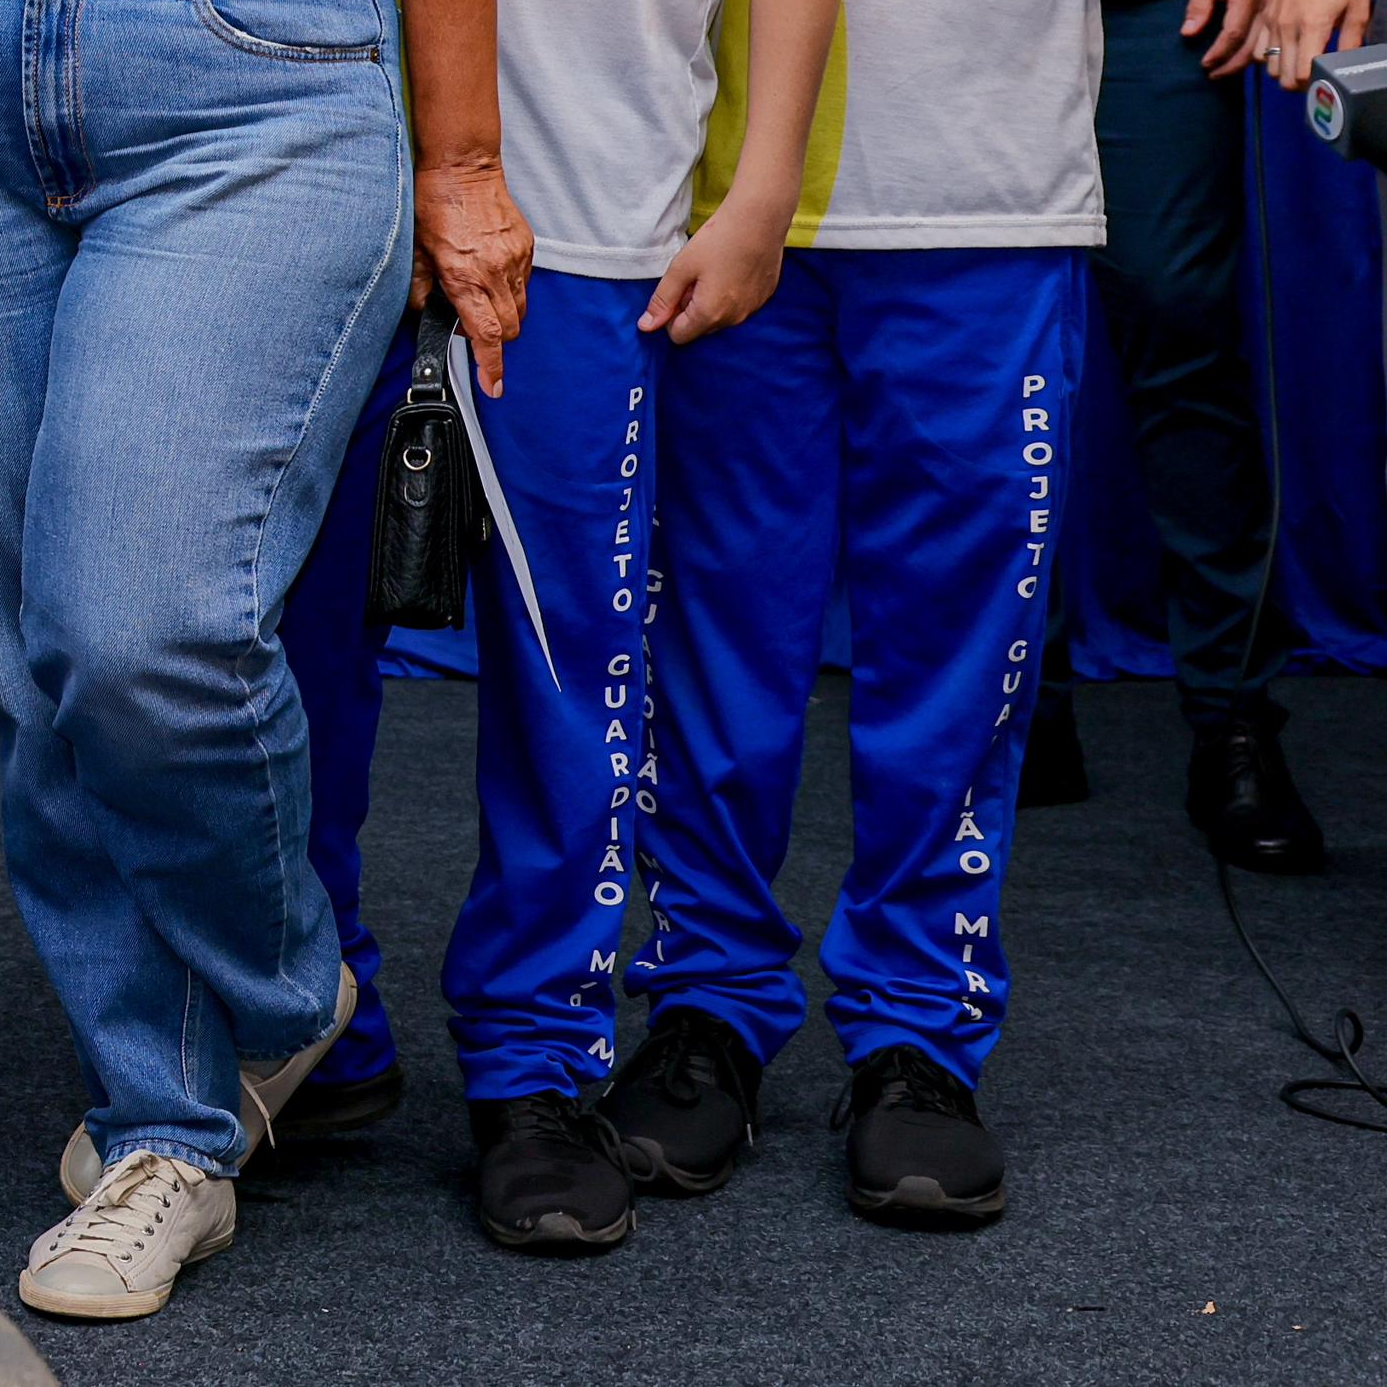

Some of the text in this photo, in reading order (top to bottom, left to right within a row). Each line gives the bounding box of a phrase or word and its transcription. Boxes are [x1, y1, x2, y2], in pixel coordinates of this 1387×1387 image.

[612, 386, 644, 613] PROJETO
[1017, 374, 1053, 599] PROJETO
[594, 653, 631, 906] GUARDIÃO
